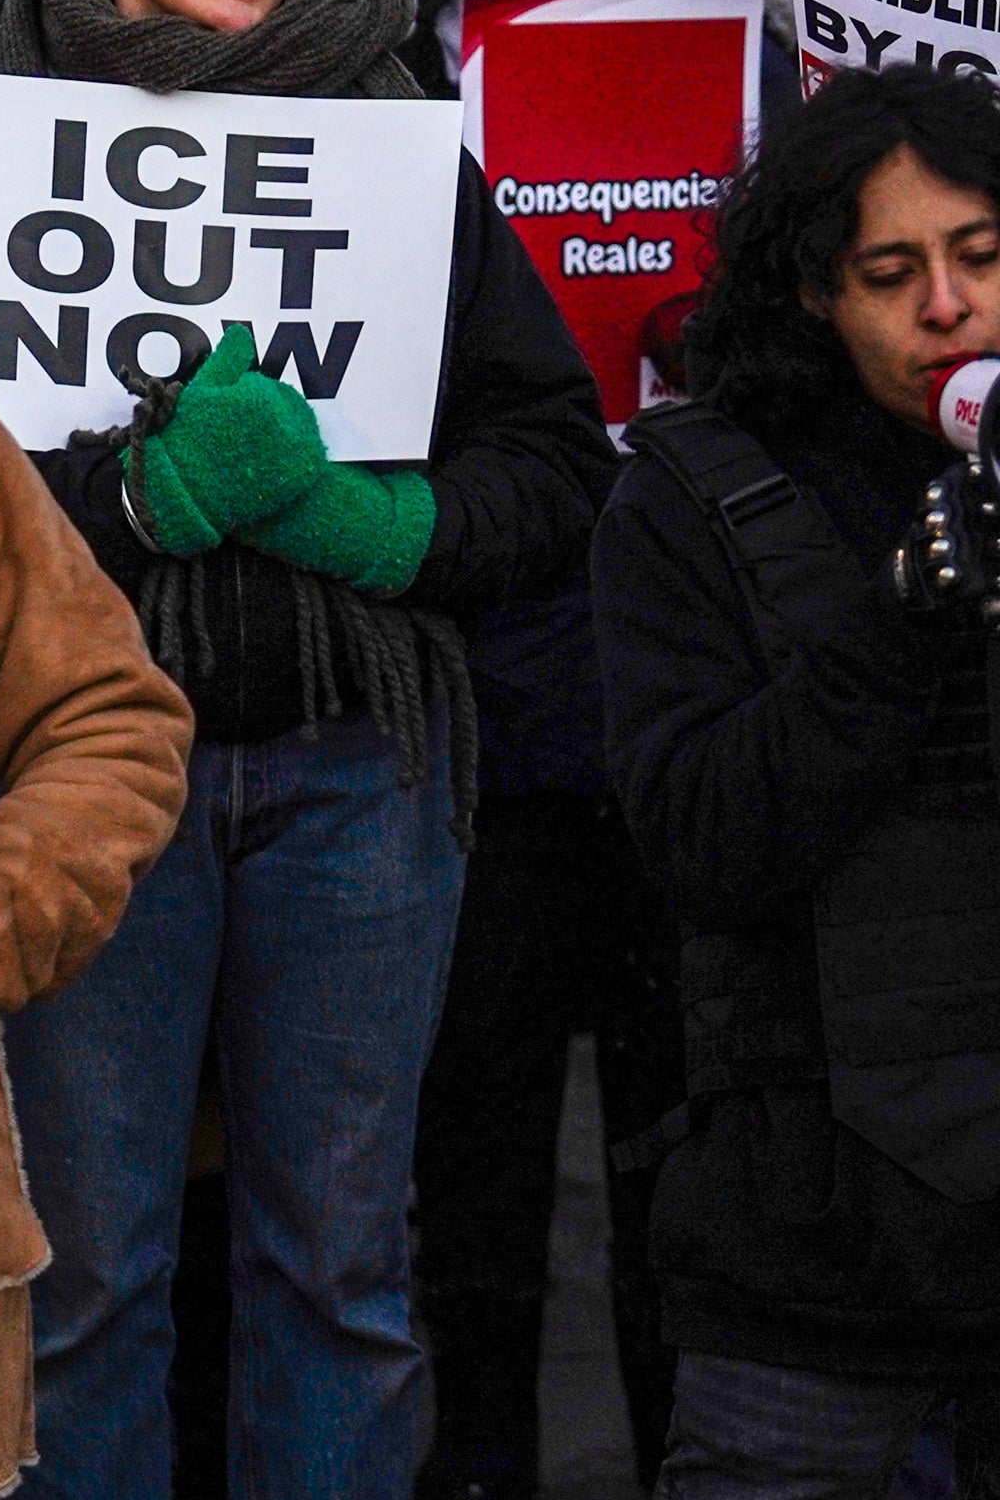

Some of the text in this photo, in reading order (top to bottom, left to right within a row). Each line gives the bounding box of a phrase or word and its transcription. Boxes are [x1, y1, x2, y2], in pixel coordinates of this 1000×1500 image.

[50, 118, 316, 217] ICE
[7, 209, 350, 310] OUT
[561, 236, 674, 276] Reales
